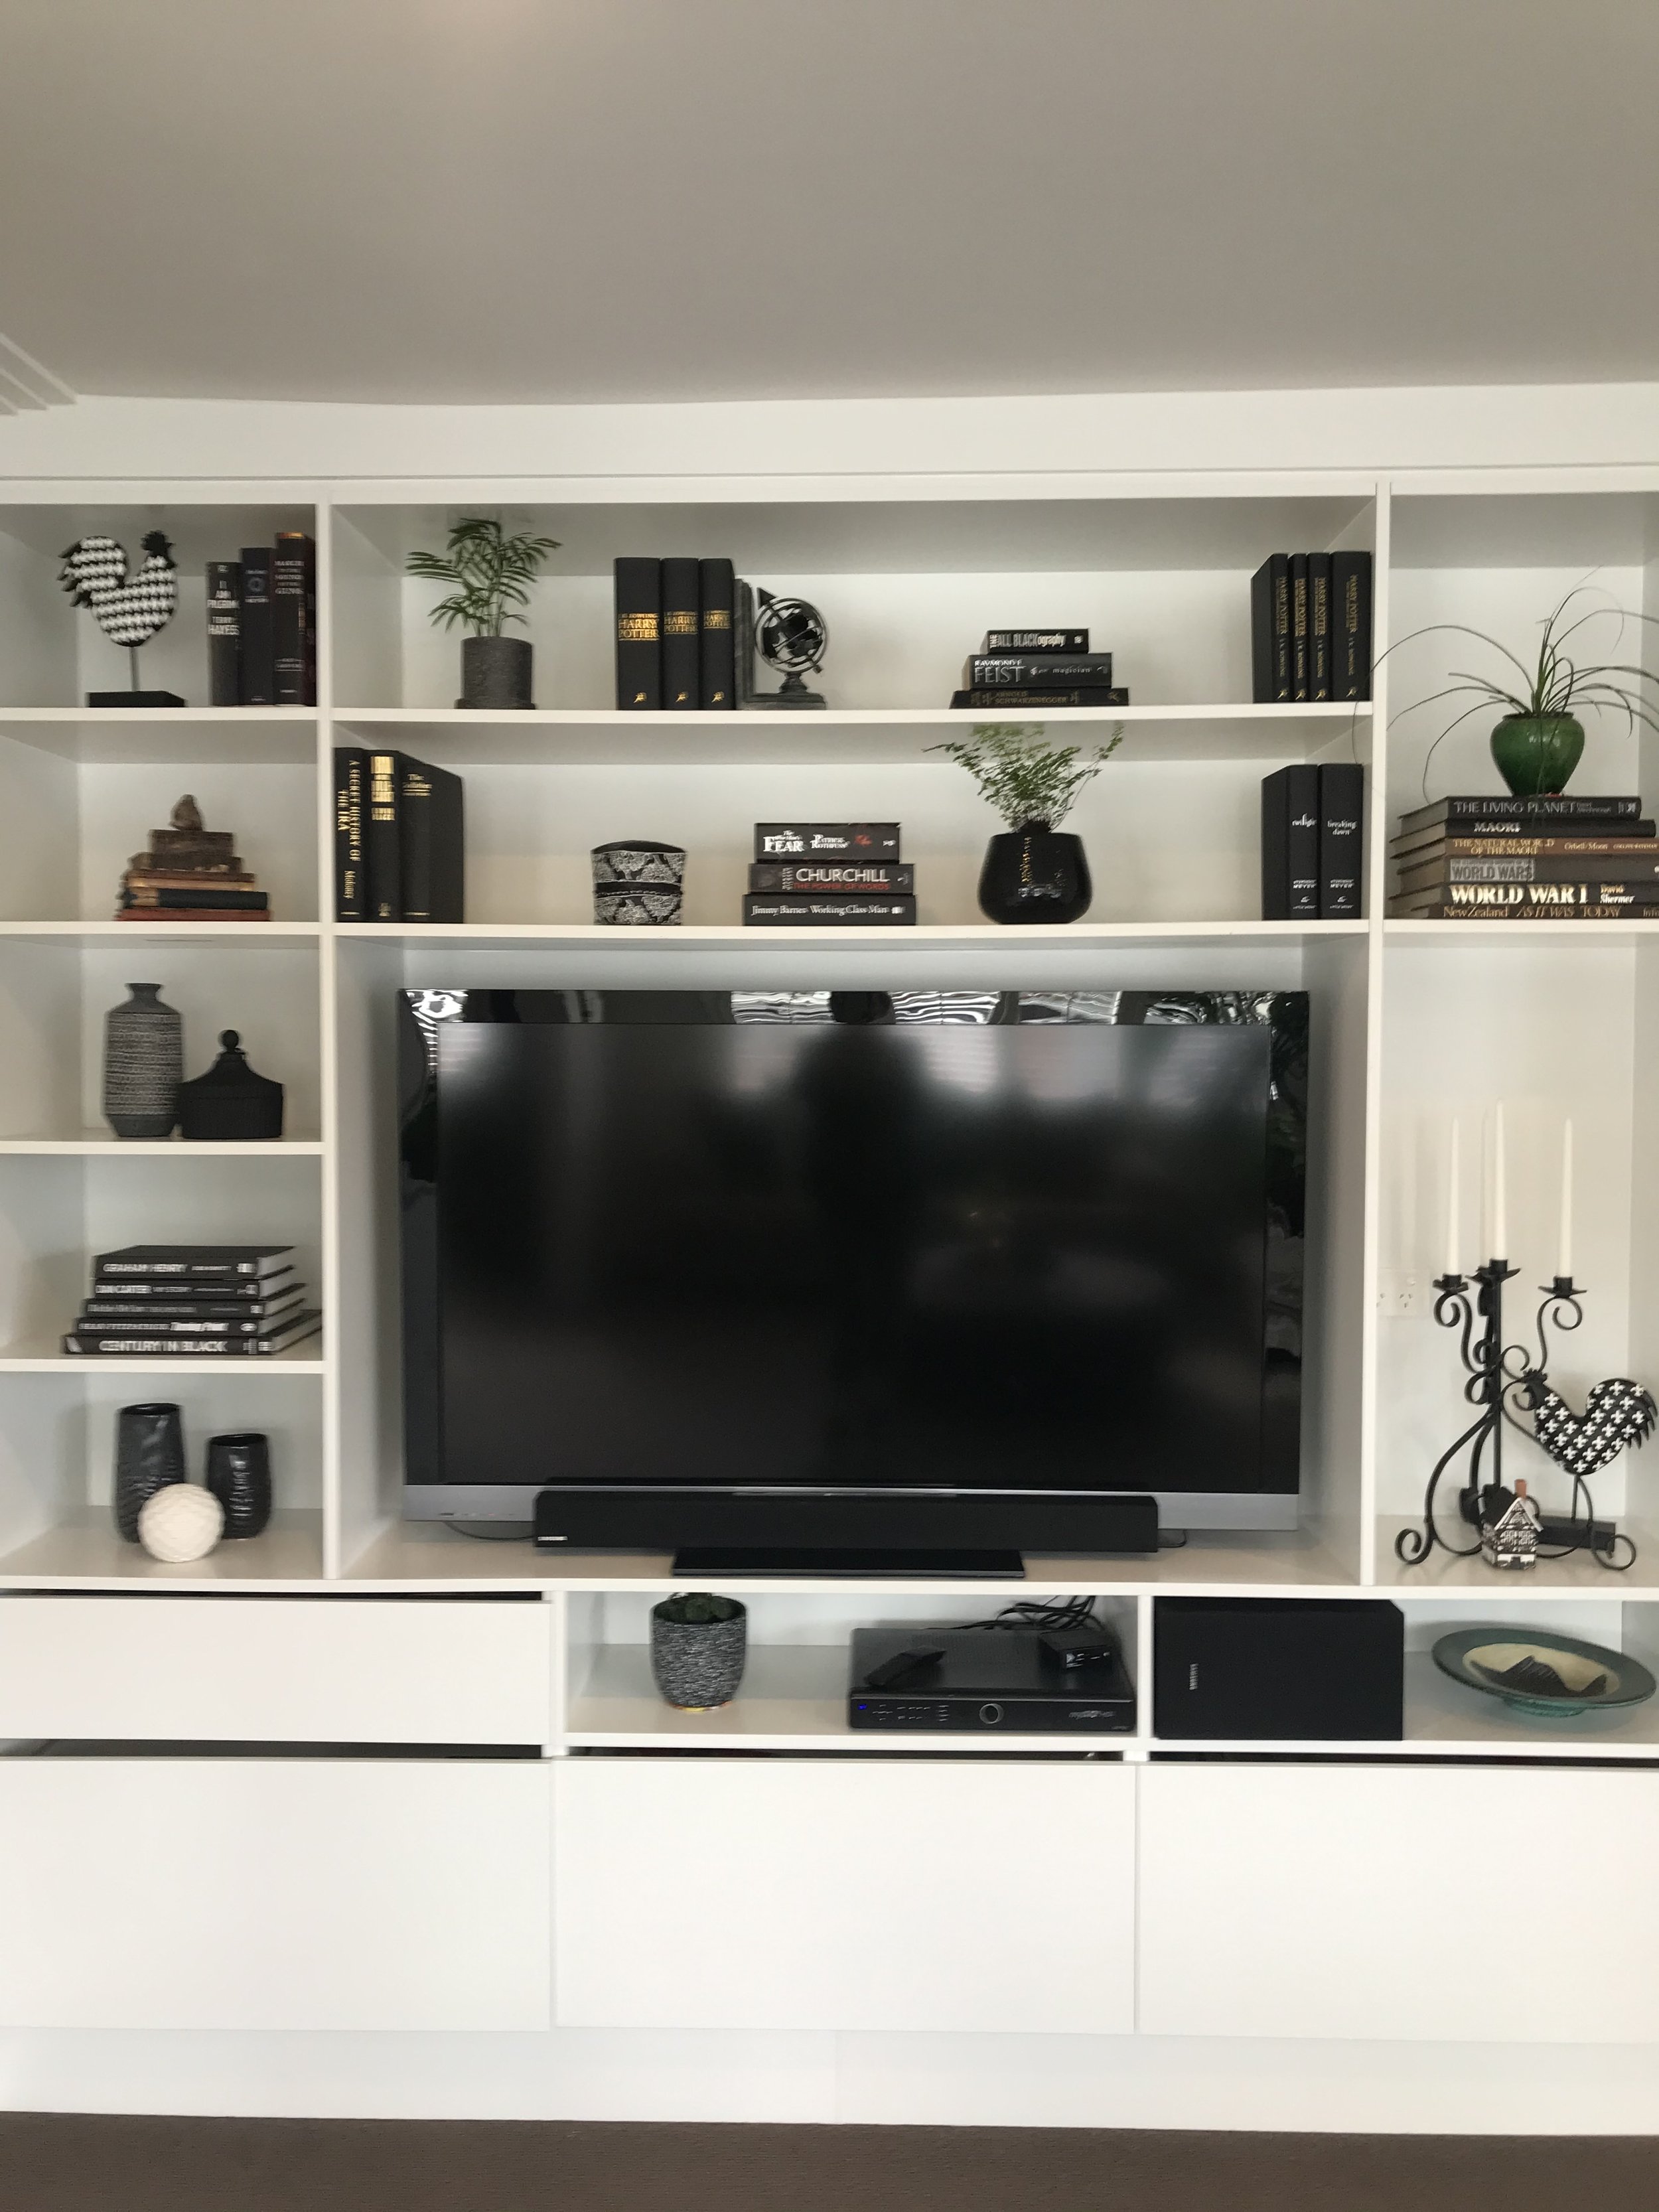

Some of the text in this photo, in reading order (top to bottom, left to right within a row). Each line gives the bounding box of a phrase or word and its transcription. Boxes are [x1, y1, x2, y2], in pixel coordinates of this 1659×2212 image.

[1279, 576, 1288, 603] HARRY
[1298, 578, 1307, 605] HARRY
[1318, 577, 1327, 605] HARRY
[1349, 574, 1358, 601] HARRY
[618, 619, 659, 628] HARRY
[664, 616, 697, 625] HARRY
[1279, 604, 1288, 634] POTTER
[1298, 607, 1307, 636] POTTER
[1318, 606, 1327, 636] POTTER
[1349, 603, 1358, 633] POTTER
[618, 629, 660, 638] POTTER
[989, 634, 998, 648] THE
[997, 634, 1012, 647] ALL
[974, 666, 1027, 684] FEIST
[1052, 666, 1091, 674] magician
[349, 769, 360, 803] SECRET
[338, 790, 351, 830] THE IRA
[1453, 801, 1480, 813] THE
[1482, 801, 1524, 813] LIVING
[1528, 801, 1576, 814] PLANET
[349, 806, 360, 846] HISTORY
[1327, 819, 1358, 830] breaking
[1473, 821, 1522, 833] MAORI
[1453, 838, 1473, 848] THE
[1475, 838, 1520, 848] NATURAL
[349, 849, 361, 861] OF
[796, 867, 891, 882] CHURCHILL
[1452, 865, 1534, 881] WORLD WARS
[343, 870, 356, 899] Moloney
[1449, 883, 1526, 905] WORLD
[1528, 883, 1577, 905] WAR
[1600, 893, 1635, 904] Shermer
[751, 905, 889, 916] Jimmy Barnes Working Class Man
[1443, 905, 1467, 917] New
[1467, 905, 1509, 918] Zealand
[1516, 905, 1533, 918] AS
[1534, 905, 1548, 918] IT
[1550, 905, 1575, 917] WAS
[1581, 905, 1621, 918] TODAY
[99, 1341, 161, 1352] CENTURY
[181, 1341, 228, 1352] BLACK
